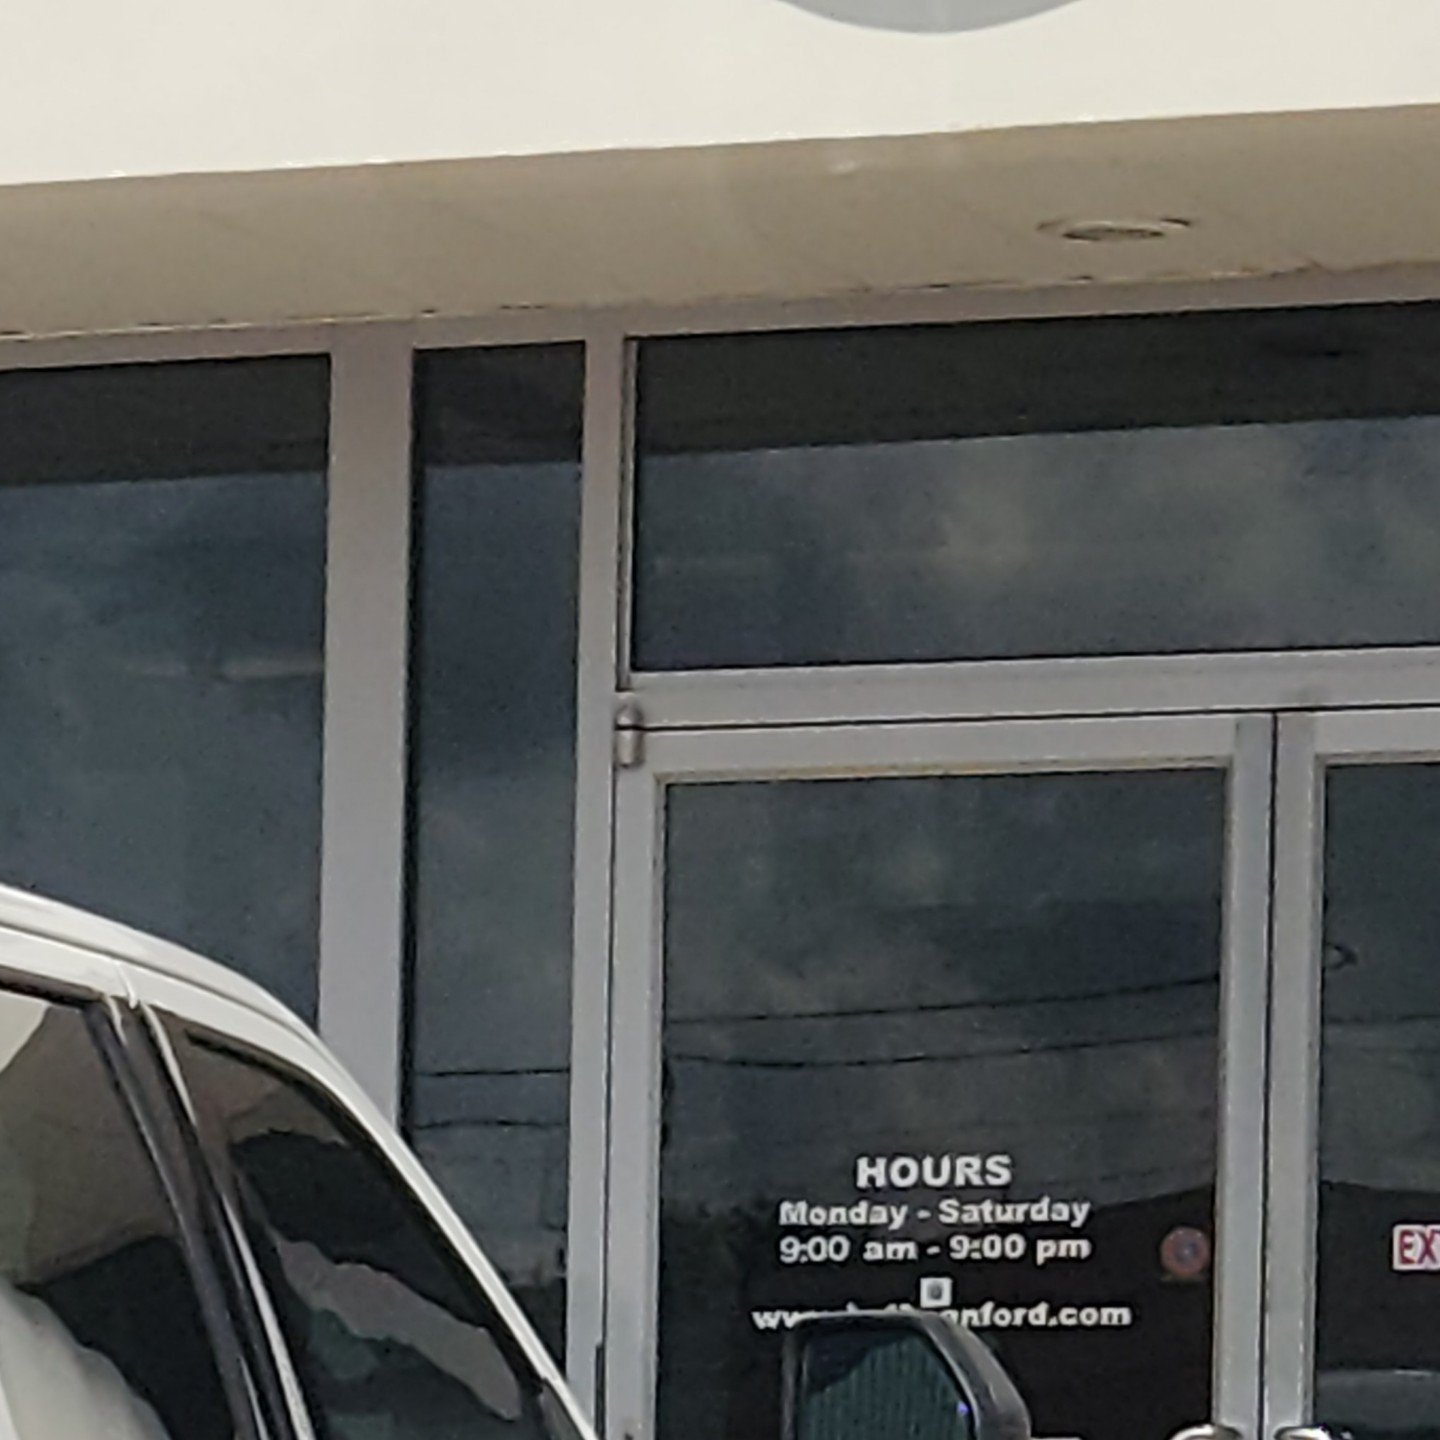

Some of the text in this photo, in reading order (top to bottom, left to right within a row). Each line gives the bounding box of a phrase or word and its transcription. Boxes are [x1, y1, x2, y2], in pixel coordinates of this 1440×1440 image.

[855, 1154, 1013, 1189] HOURS
[779, 1200, 909, 1230] Monday
[938, 1196, 1091, 1227] Saturday
[779, 1236, 850, 1263] 9:00
[862, 1239, 918, 1261] am
[949, 1234, 1026, 1260] 9:00
[1035, 1238, 1093, 1265] pm
[1398, 1228, 1440, 1265] EX
